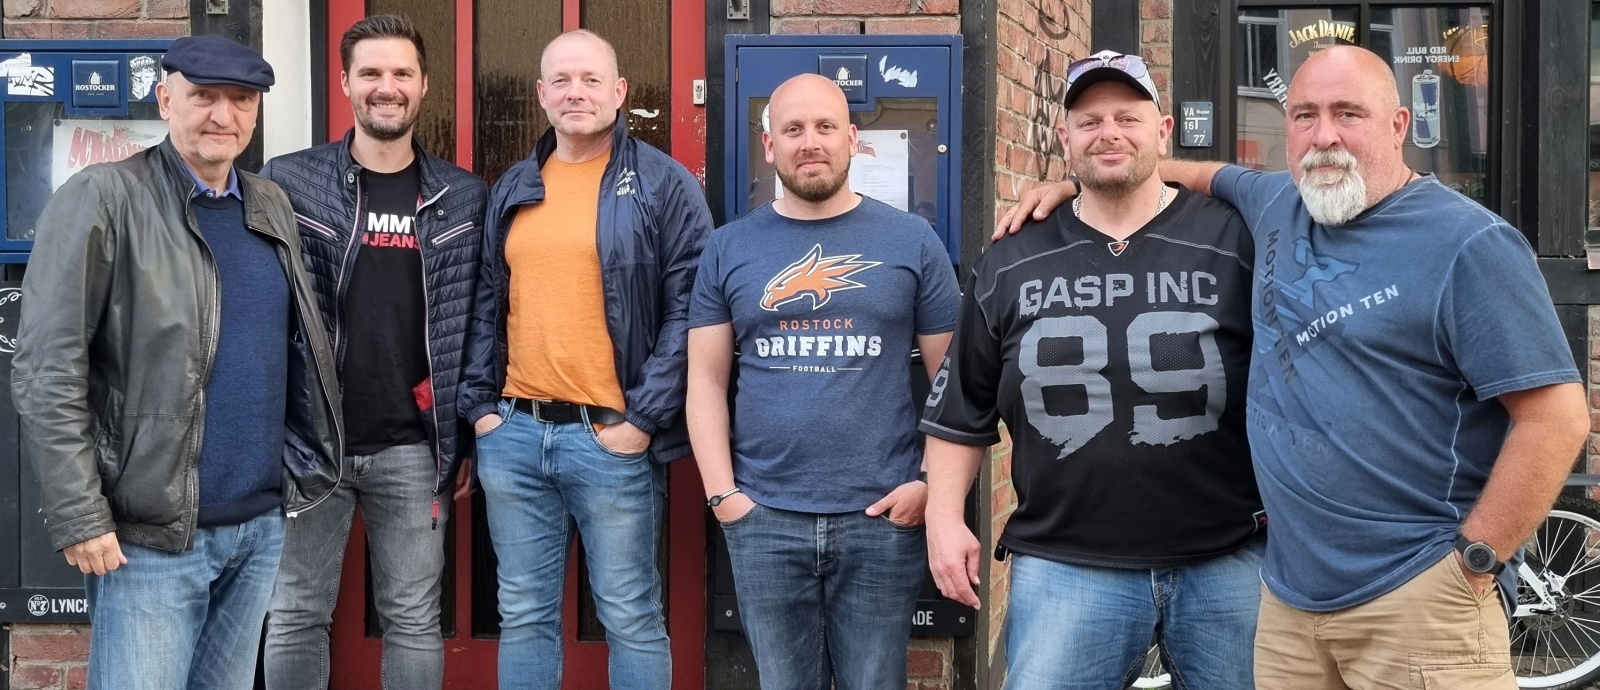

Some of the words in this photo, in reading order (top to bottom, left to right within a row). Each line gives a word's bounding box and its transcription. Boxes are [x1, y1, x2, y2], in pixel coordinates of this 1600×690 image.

[1288, 23, 1319, 48] JACK
[1183, 107, 1195, 117] VA
[367, 212, 416, 234] MM
[1019, 273, 1134, 319] GASP
[1146, 271, 1219, 308] INC
[780, 318, 854, 331] ROSTOCK
[1295, 303, 1354, 347] MOTION
[1359, 284, 1399, 310] TEN
[755, 335, 882, 358] GRIFFINS
[792, 365, 836, 373] FOOTBALL
[1018, 311, 1227, 460] 89
